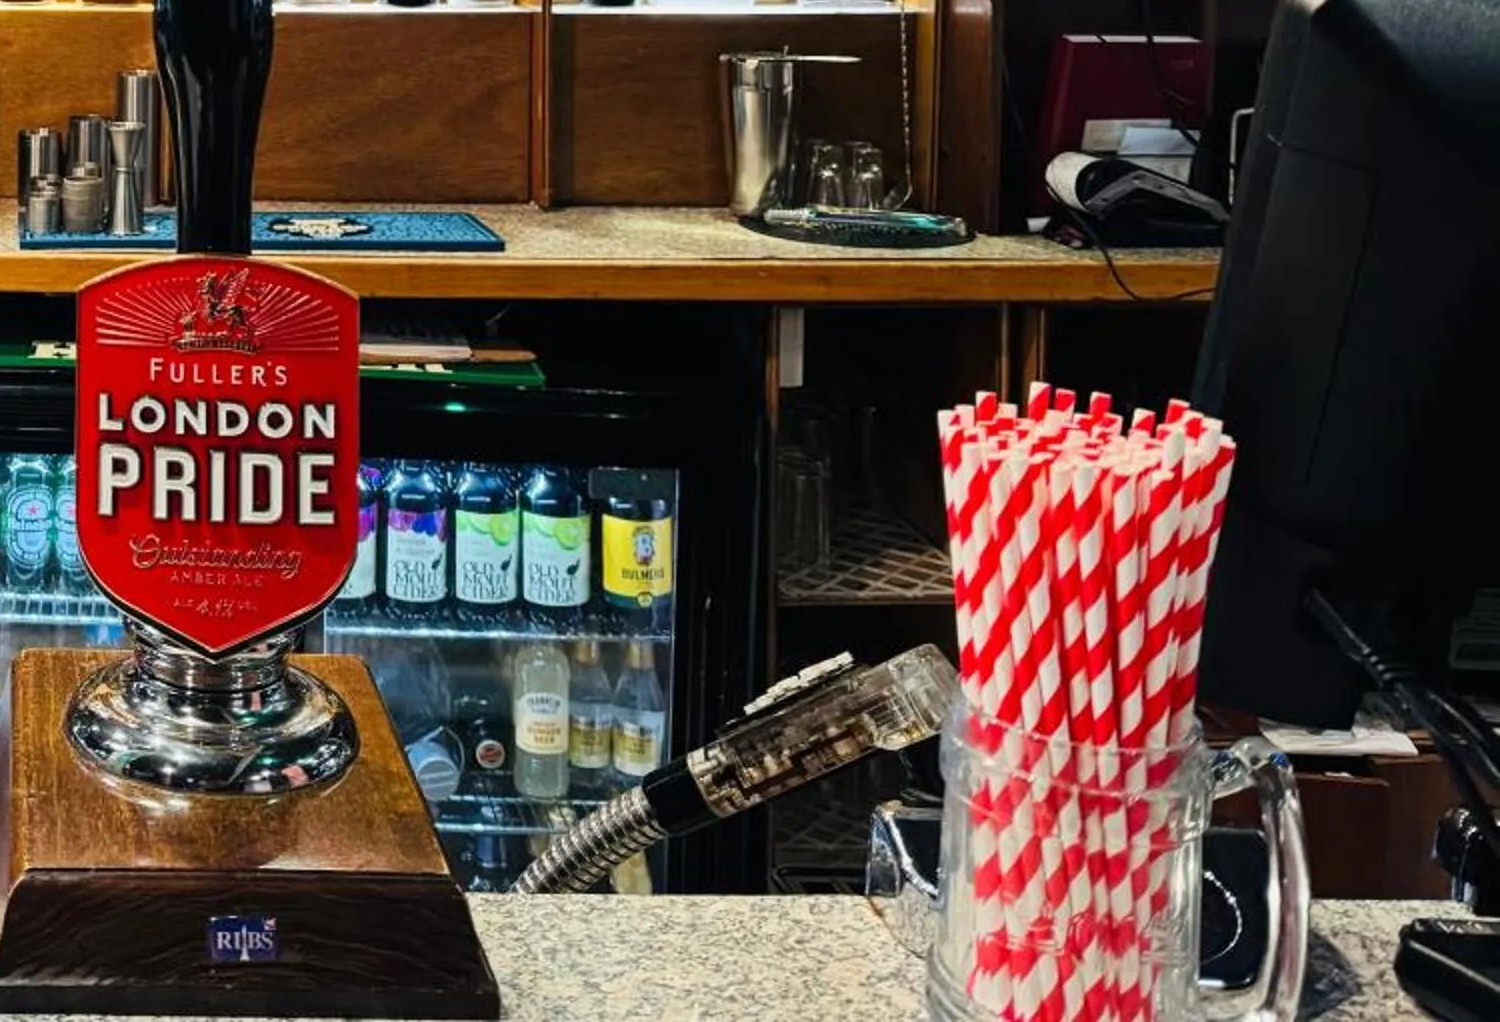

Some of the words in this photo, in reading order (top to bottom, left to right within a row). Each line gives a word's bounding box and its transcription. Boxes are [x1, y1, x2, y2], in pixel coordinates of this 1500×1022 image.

[149, 355, 288, 387] FULLER'S
[97, 392, 336, 441] LONDON
[97, 442, 336, 526] PRIDE
[129, 533, 303, 580] Outstanding
[170, 570, 227, 586] AMBER
